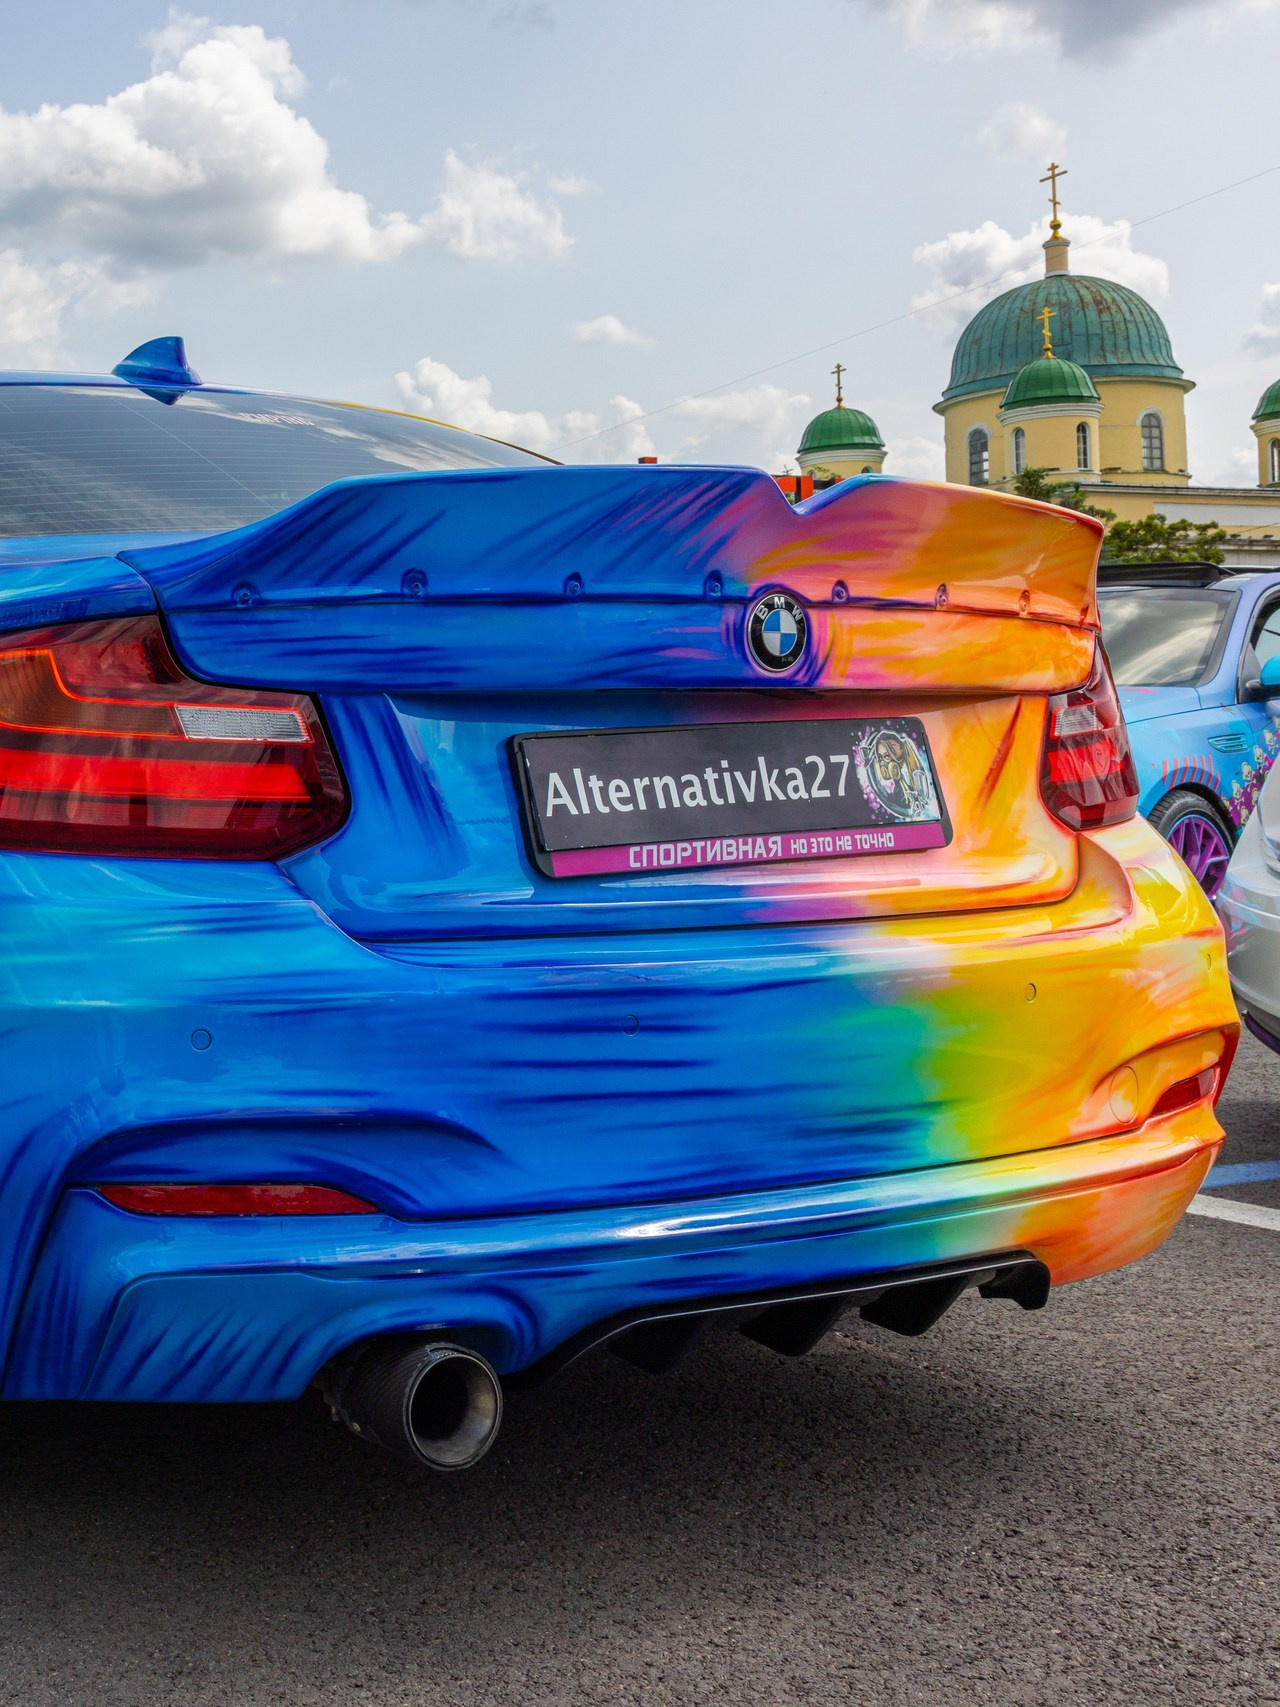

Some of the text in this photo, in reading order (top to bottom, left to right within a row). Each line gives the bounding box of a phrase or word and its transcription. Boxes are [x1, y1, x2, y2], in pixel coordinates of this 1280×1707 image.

[755, 596, 804, 621] BMW
[546, 754, 849, 818] Alternativka27
[629, 836, 782, 868] СПОРТИВНАЯ
